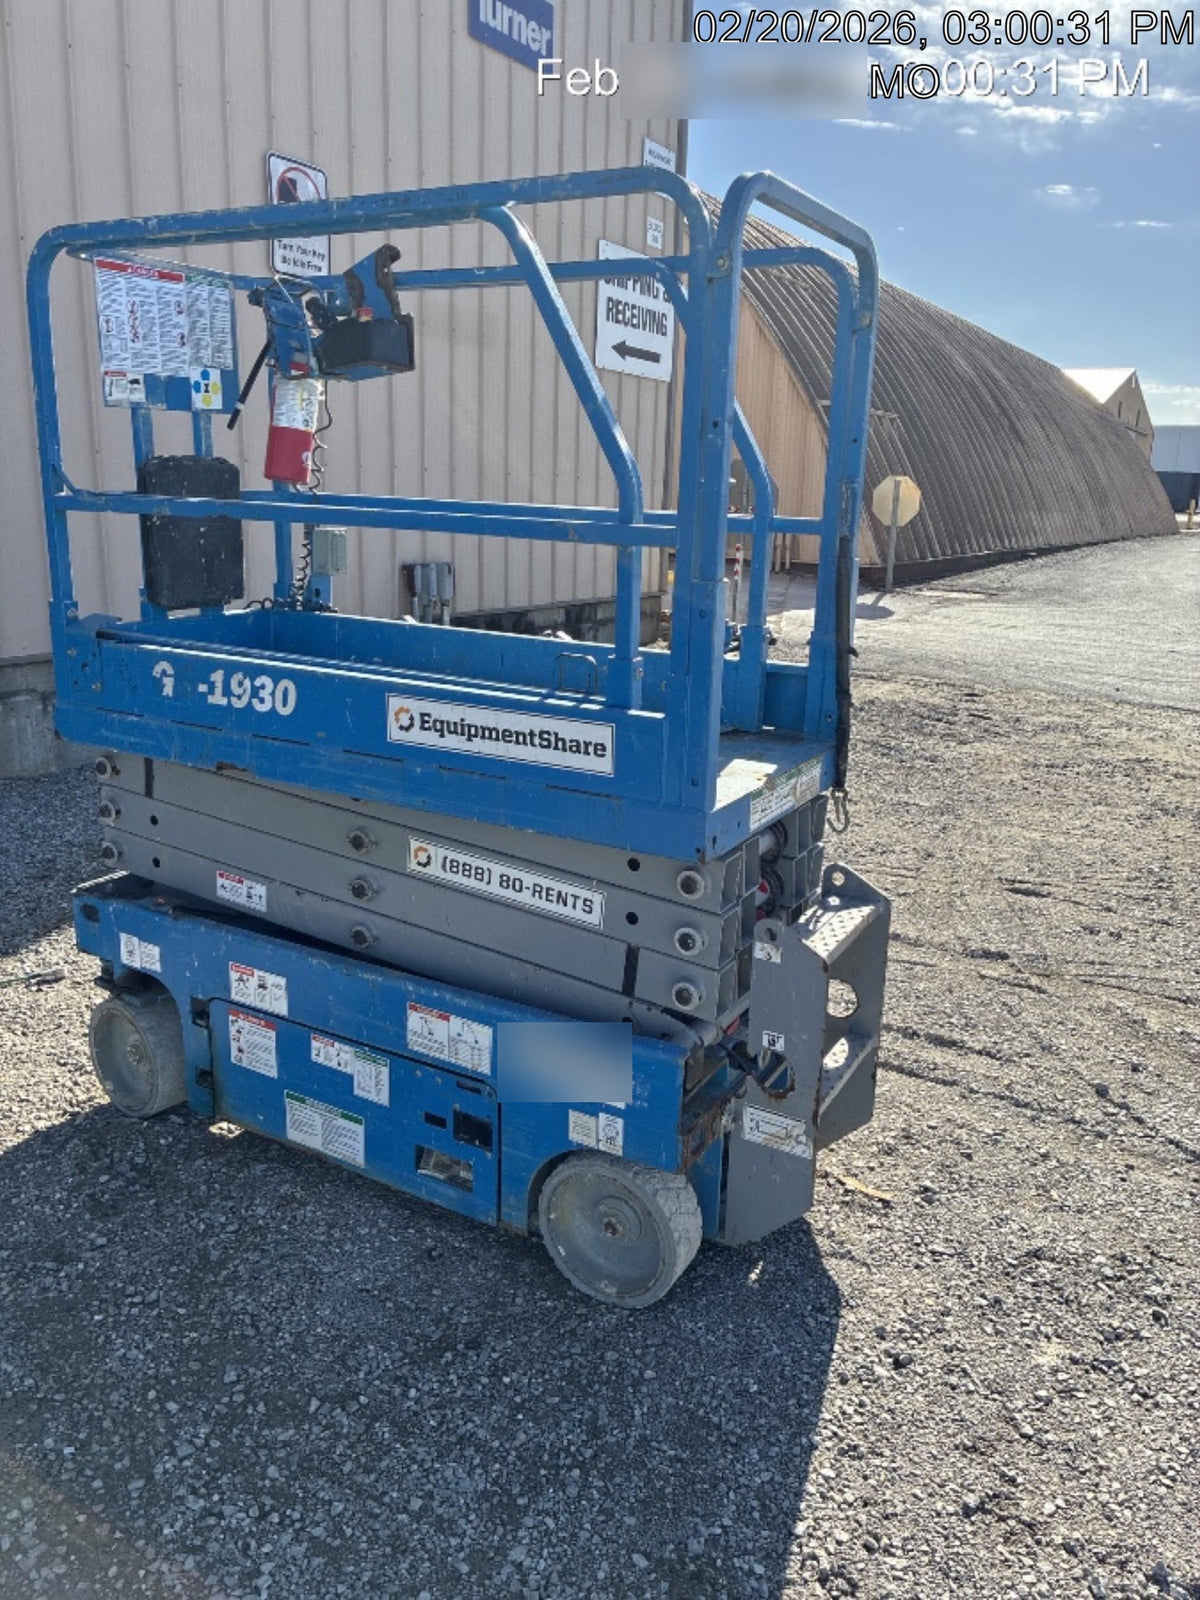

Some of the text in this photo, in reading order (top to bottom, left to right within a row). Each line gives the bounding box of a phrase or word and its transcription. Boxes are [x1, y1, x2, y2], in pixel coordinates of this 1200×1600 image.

[606, 296, 668, 337] RECEIVING
[418, 712, 607, 758] EquipmentShare
[441, 855, 595, 915] (888) 80-RENTS
